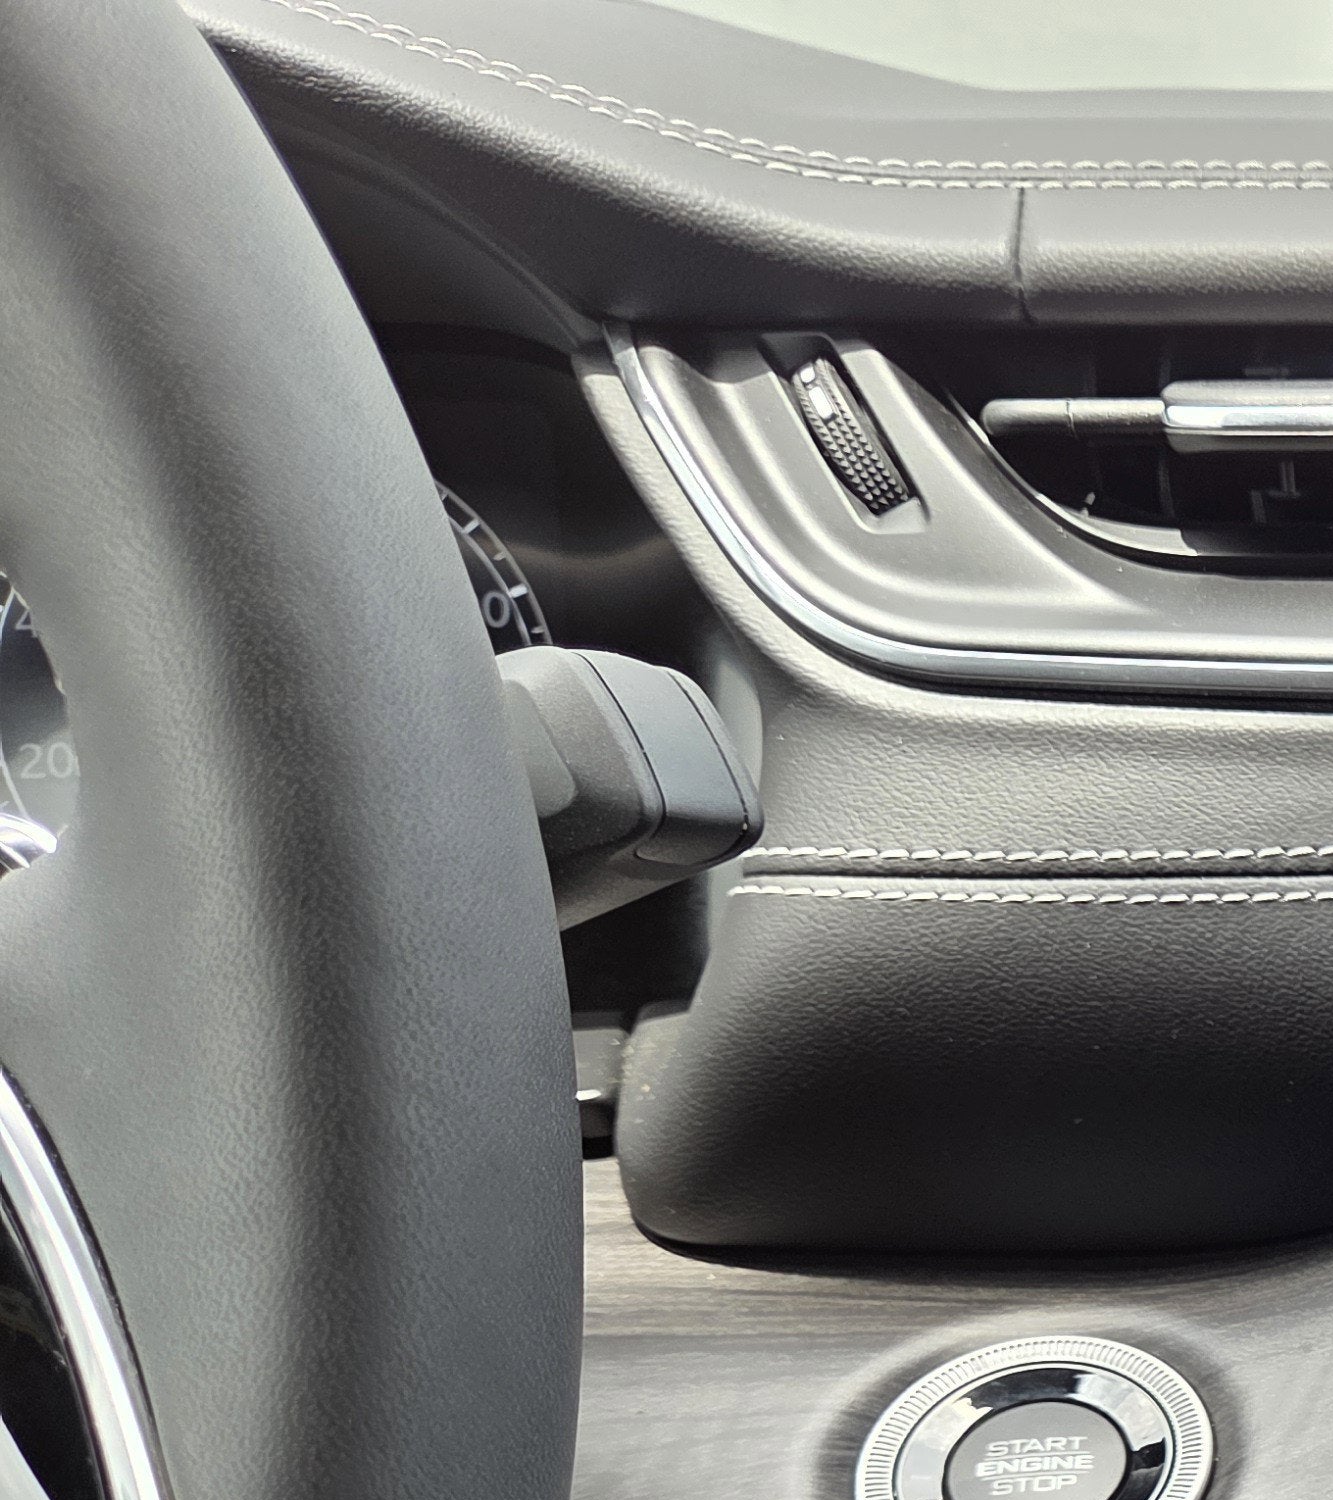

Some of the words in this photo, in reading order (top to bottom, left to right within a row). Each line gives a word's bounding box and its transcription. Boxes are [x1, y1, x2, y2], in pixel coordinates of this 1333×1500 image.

[985, 1436, 1088, 1456] START
[976, 1454, 1095, 1476] ENGINE
[990, 1475, 1078, 1495] STOP
